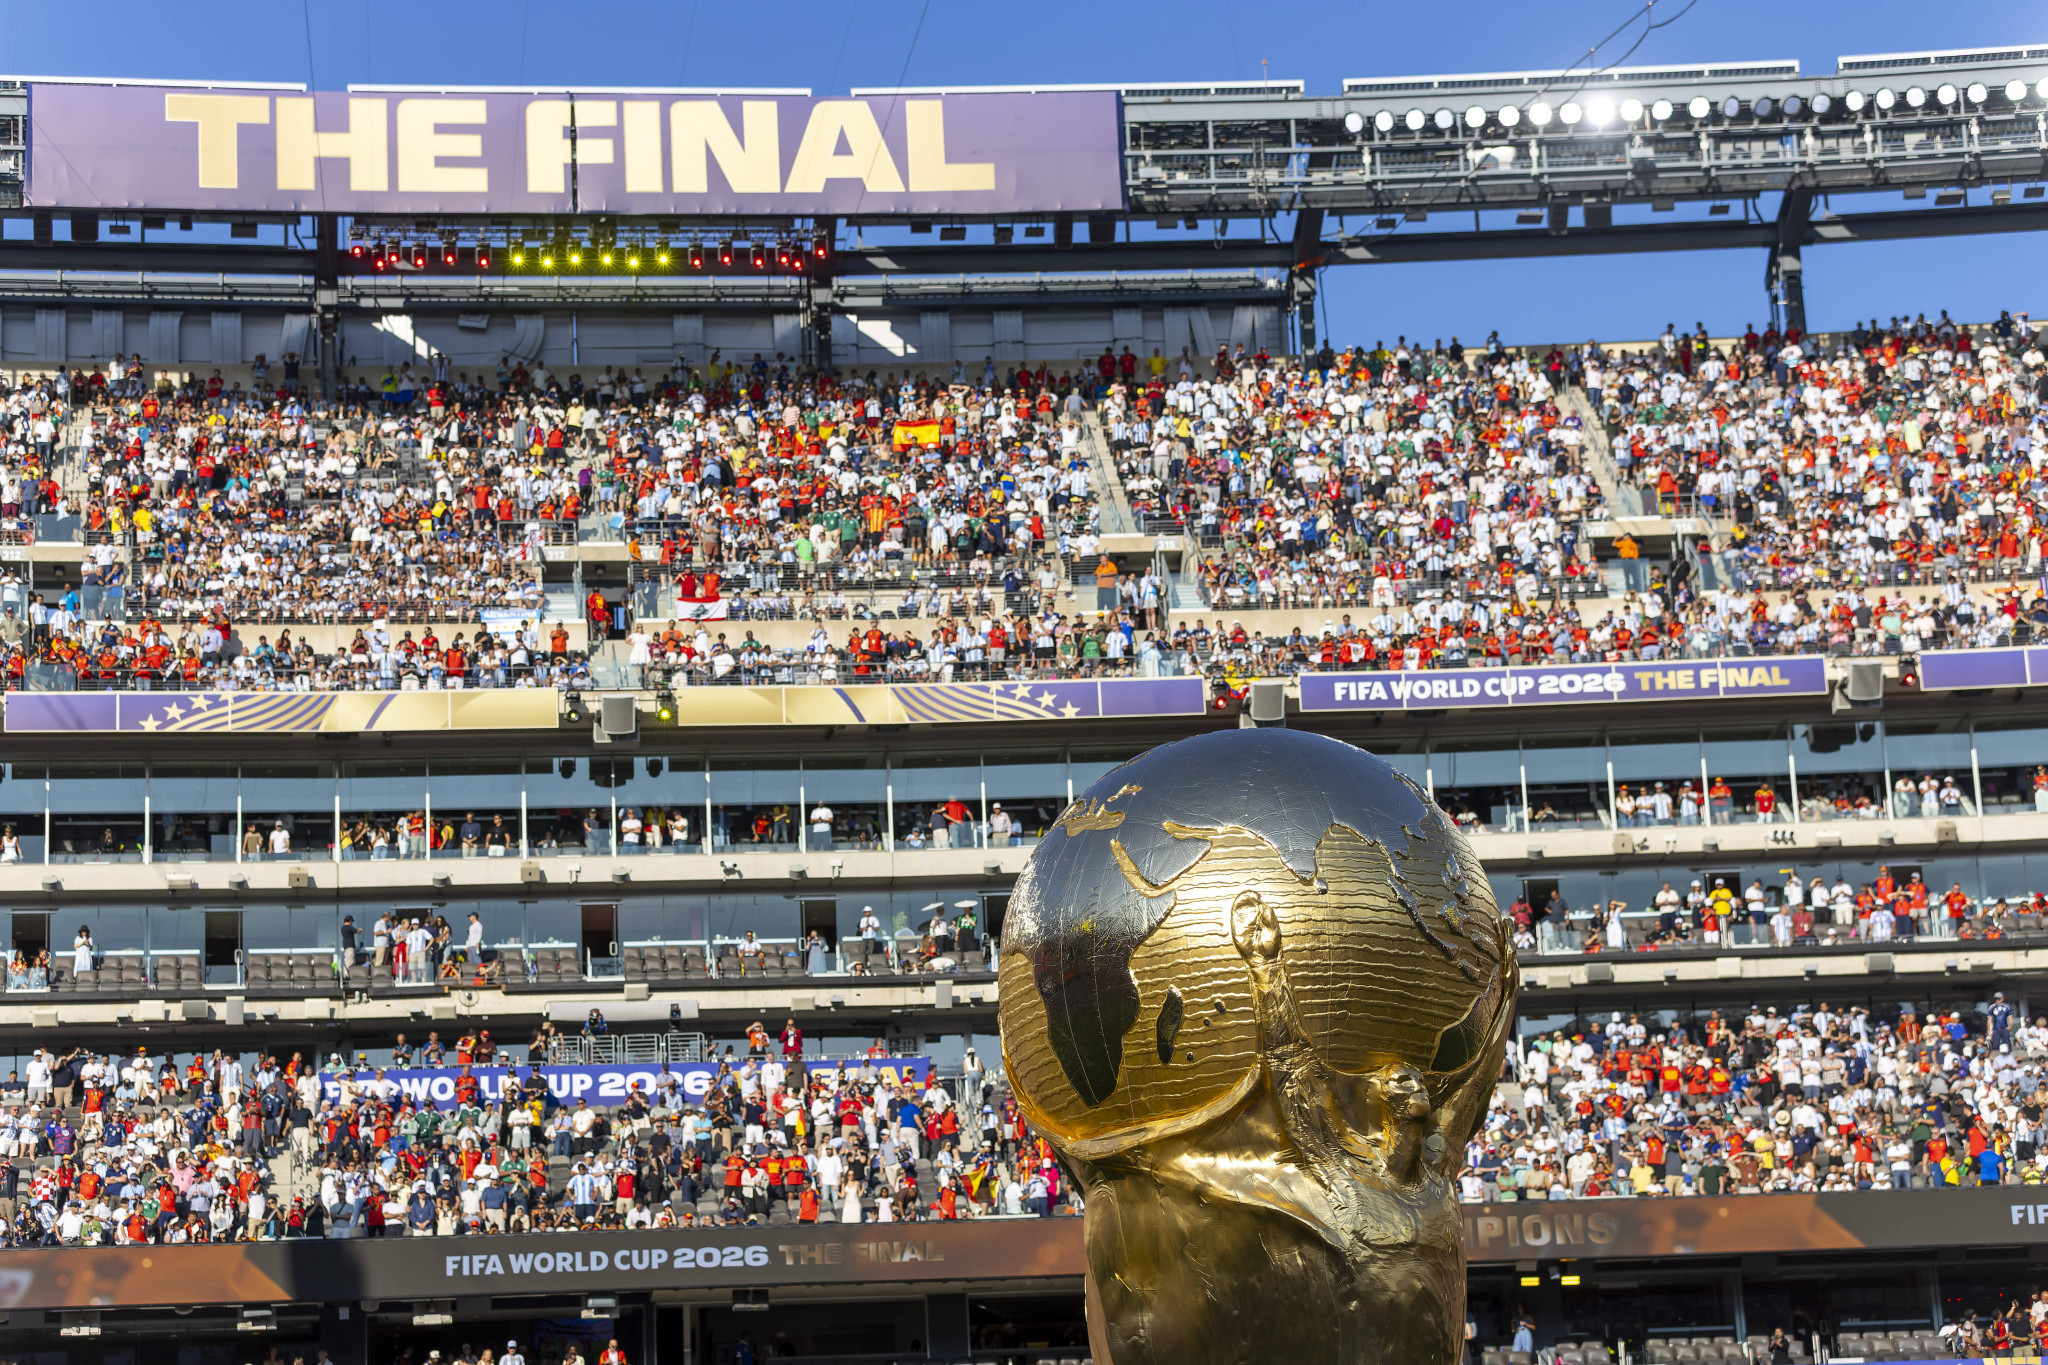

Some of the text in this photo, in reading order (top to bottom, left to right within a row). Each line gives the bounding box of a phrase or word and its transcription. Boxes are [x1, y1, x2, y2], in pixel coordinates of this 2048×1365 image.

[165, 94, 995, 193] THE FINAL
[2, 550, 21, 560] 312
[1334, 666, 1790, 701] FIFA WORLD CUP 2026 THE FINAL
[446, 1240, 945, 1277] FIFA WORLD CUP 2026 THE FINAL
